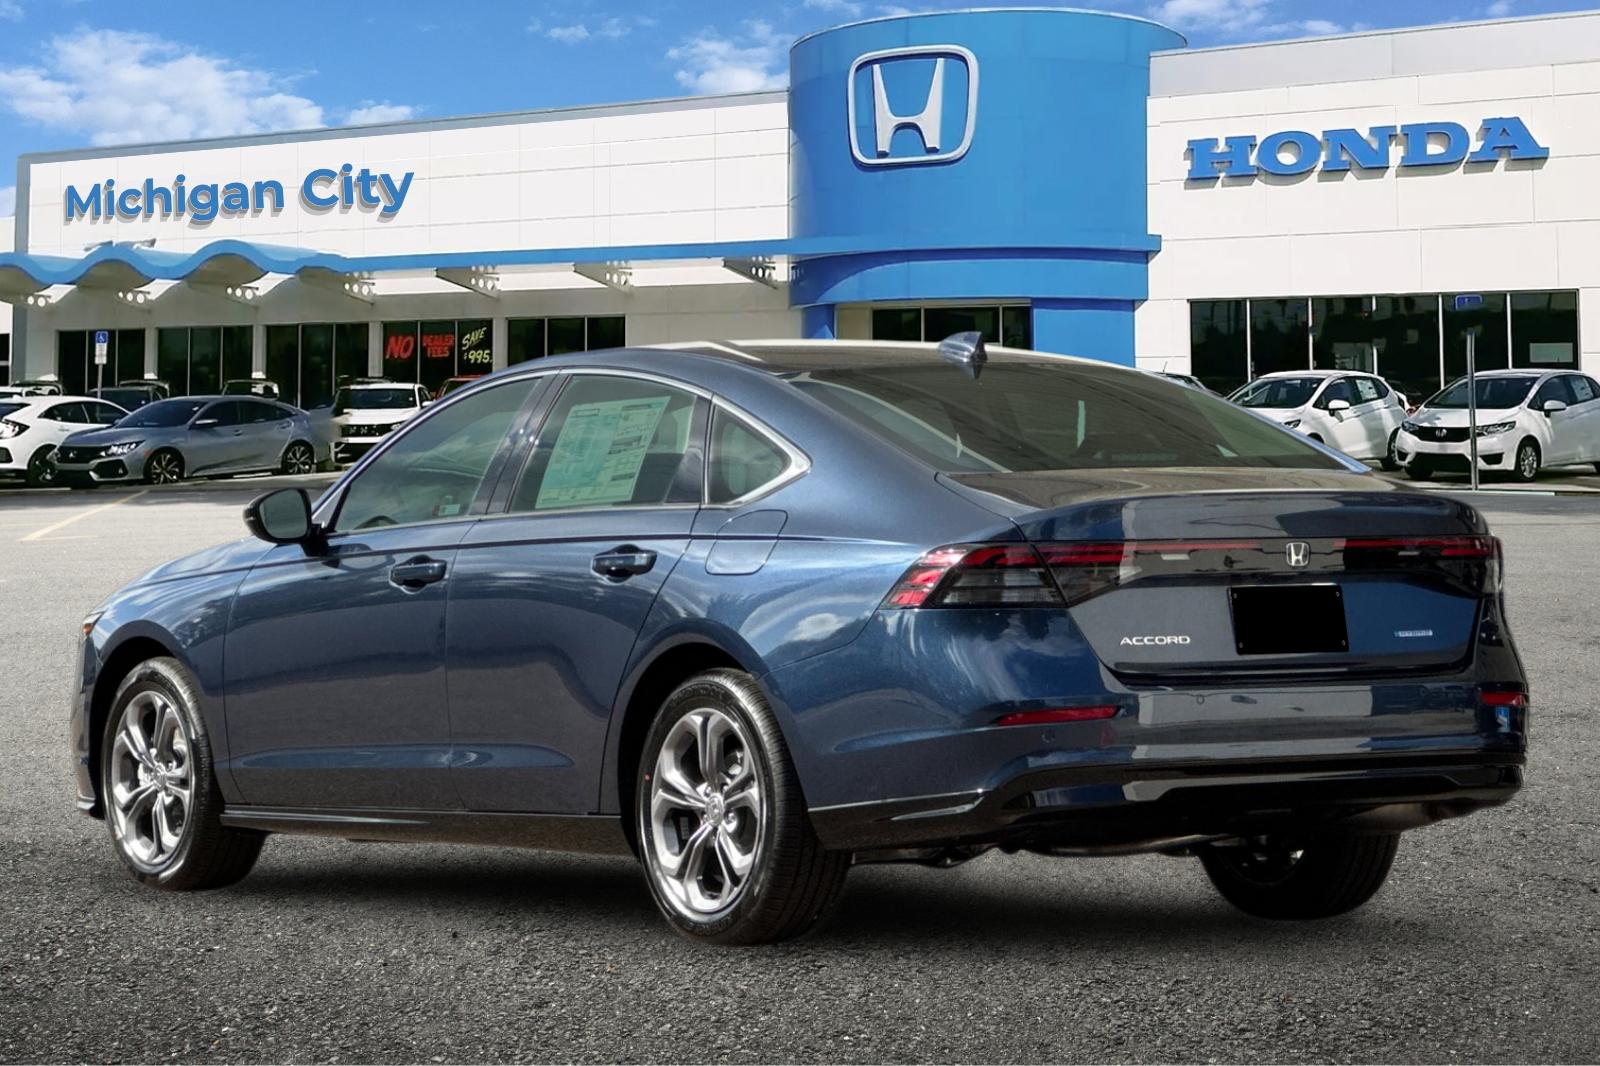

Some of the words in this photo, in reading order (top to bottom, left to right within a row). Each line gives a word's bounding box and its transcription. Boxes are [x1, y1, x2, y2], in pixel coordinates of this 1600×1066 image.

[1186, 116, 1550, 182] HONDA
[65, 173, 285, 226] Michigan
[302, 162, 415, 218] City
[385, 335, 415, 359] NO
[462, 327, 487, 350] SAVE
[1119, 635, 1191, 646] ACCORD
